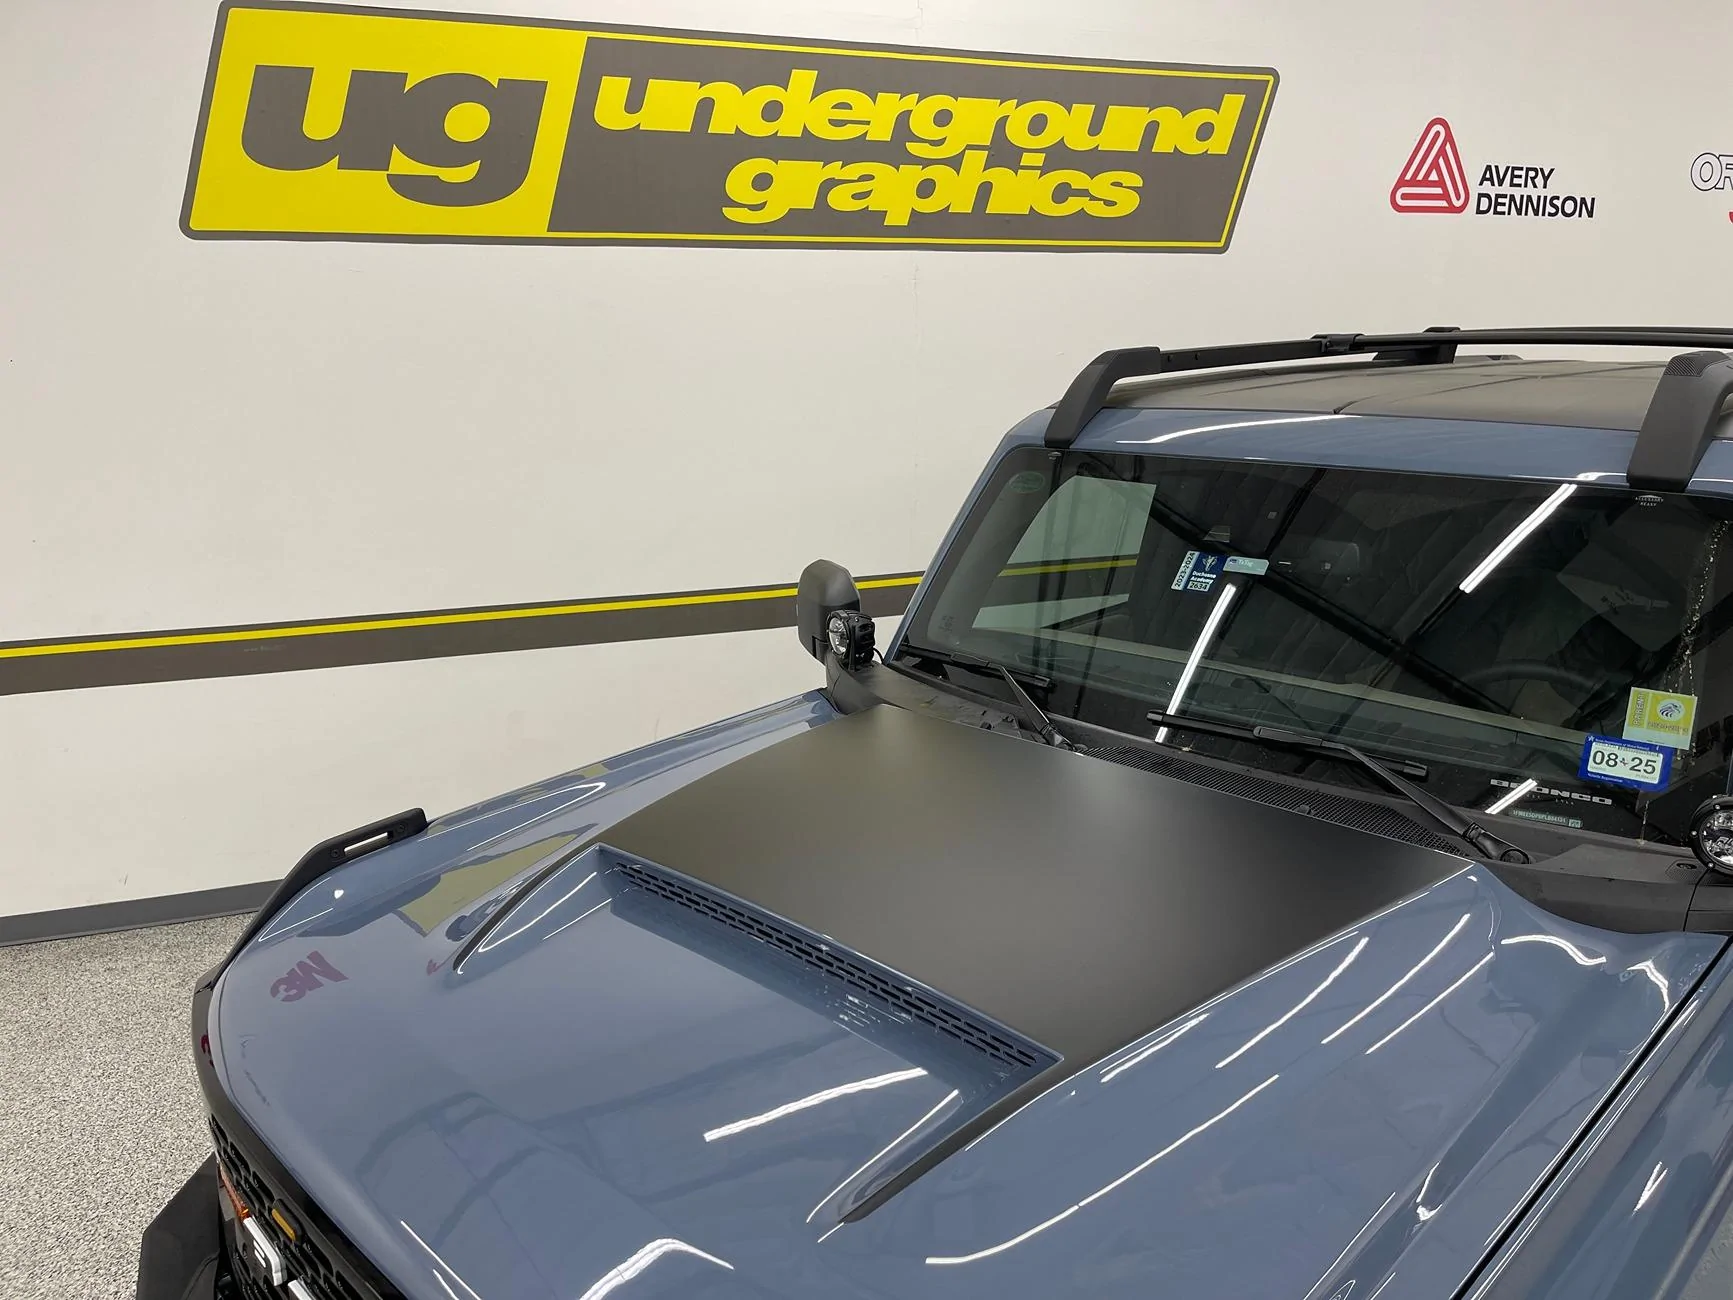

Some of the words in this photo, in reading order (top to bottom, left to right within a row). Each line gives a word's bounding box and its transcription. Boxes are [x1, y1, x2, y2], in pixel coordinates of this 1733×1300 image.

[594, 69, 1245, 159] underground
[242, 64, 548, 206] ug
[724, 150, 1141, 226] graphics
[1478, 164, 1556, 189] AVERY
[1475, 192, 1596, 218] DENNISON
[1174, 552, 1196, 588] 2023-2024
[1189, 582, 1207, 590] 2634
[1592, 750, 1618, 767] 08
[1629, 756, 1656, 774] 25
